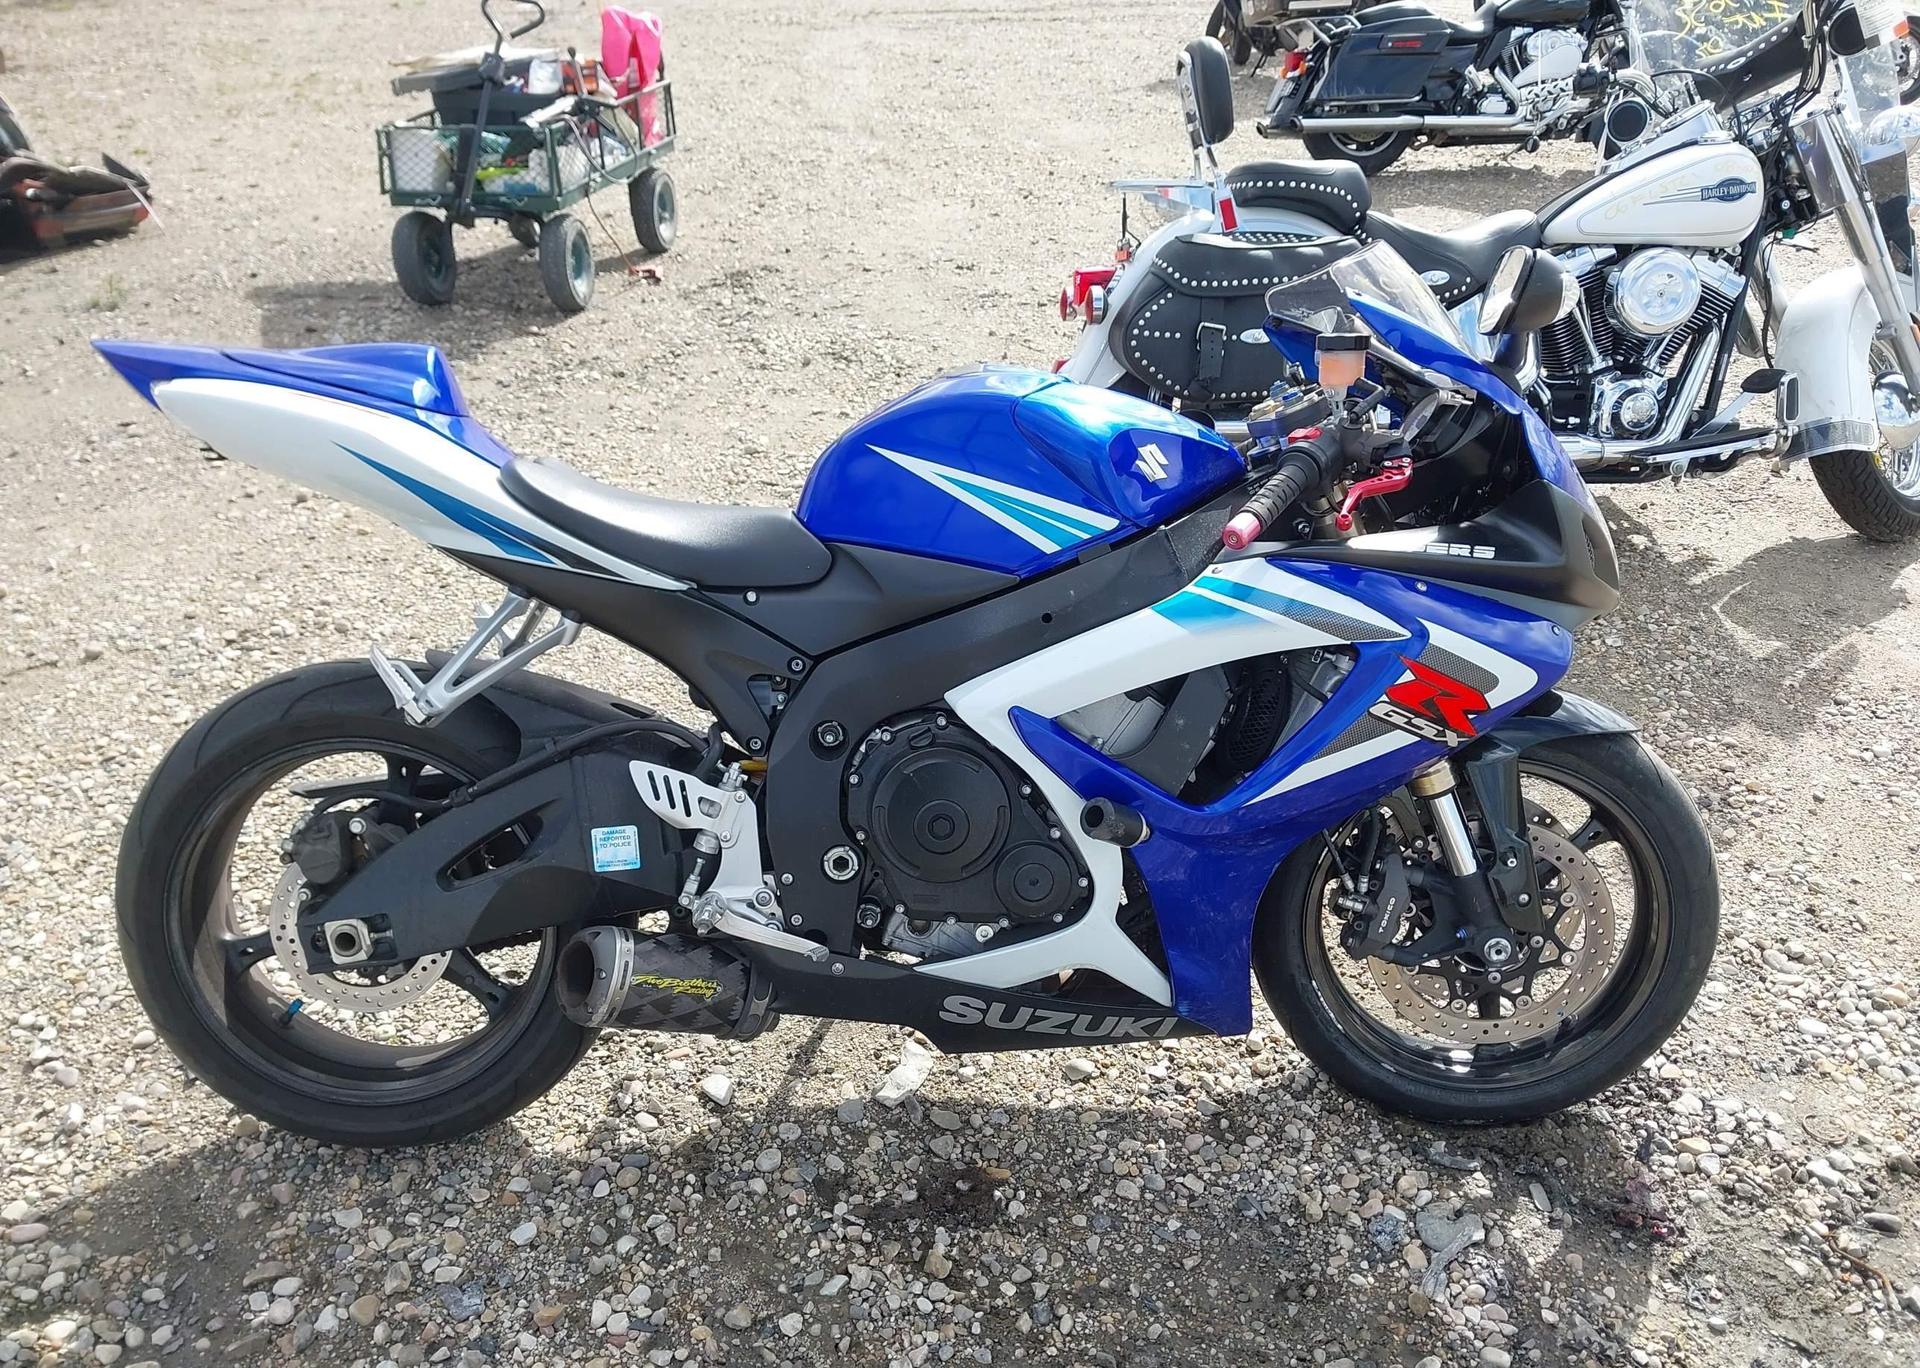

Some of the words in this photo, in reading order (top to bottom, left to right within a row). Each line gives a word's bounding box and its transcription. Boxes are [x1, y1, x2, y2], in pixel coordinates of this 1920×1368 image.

[1424, 542, 1496, 559] ERS
[1378, 897, 1396, 934] TOKICO
[938, 994, 1178, 1038] SUZUKI
